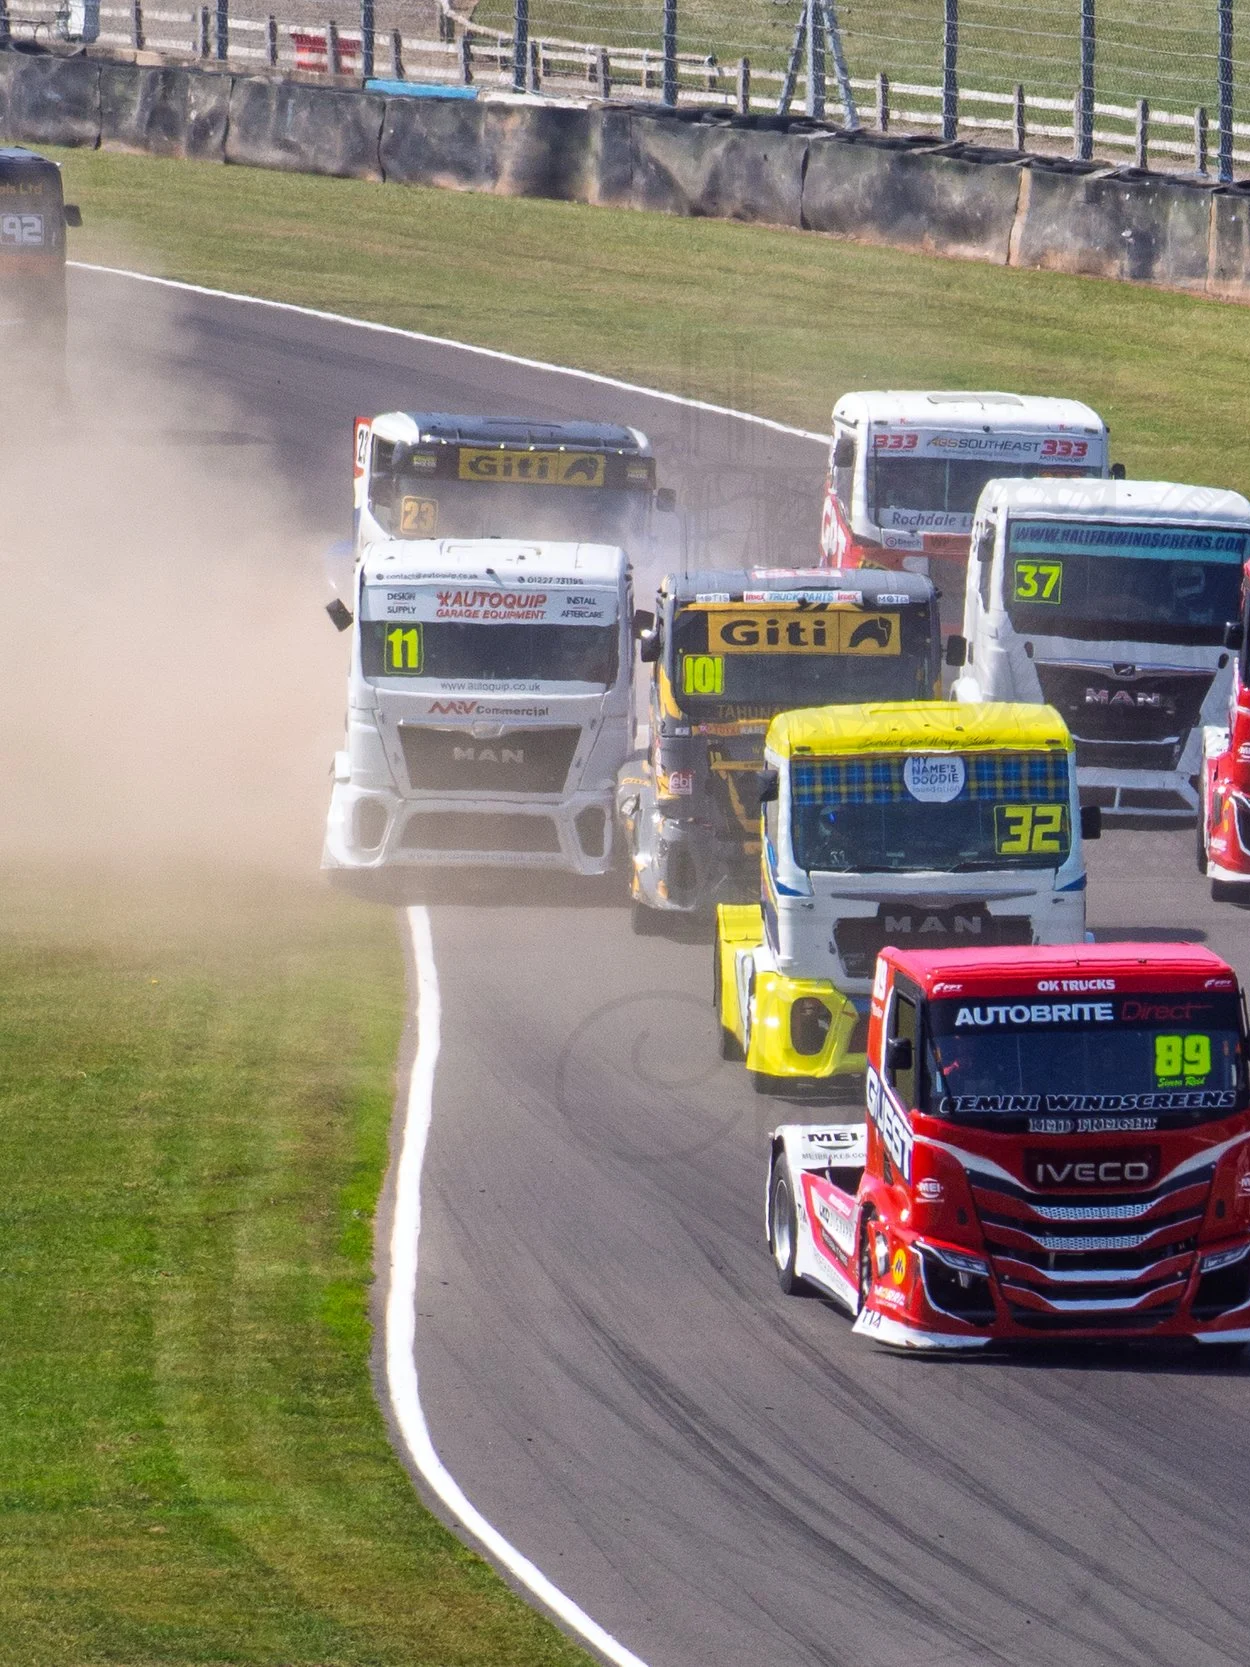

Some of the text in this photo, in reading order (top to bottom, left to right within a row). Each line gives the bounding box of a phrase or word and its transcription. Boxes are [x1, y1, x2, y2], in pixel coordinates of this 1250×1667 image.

[3, 215, 42, 243] 92
[872, 433, 919, 449] 333
[1040, 439, 1089, 457] 333
[468, 455, 550, 479] Giti
[404, 500, 435, 530] 23
[892, 511, 957, 527] Rochdale
[1016, 565, 1062, 599] 37
[387, 592, 416, 601] DESIGN
[451, 591, 548, 609] AUTOQUIP
[566, 596, 597, 606] INSTALL
[768, 592, 799, 603] TRUCK
[387, 606, 416, 614] SUPPLY
[436, 609, 547, 620] GARAGE EQUIPMENT
[561, 610, 605, 618] AFTERCARE
[720, 618, 827, 647] Giti
[388, 628, 419, 668] 11
[684, 656, 723, 694] 101
[440, 681, 541, 692] www.autoquip.co.uk
[1085, 687, 1162, 708] MAN
[476, 704, 549, 717] Commercial
[453, 747, 525, 763] MAN
[912, 756, 928, 766] MY
[1001, 805, 1063, 853] 32
[884, 914, 982, 934] MAN
[1037, 978, 1116, 992] OK TRUCKS
[954, 1001, 1213, 1027] AUTOBRITE Direct
[1154, 1034, 1212, 1077] 89
[939, 1091, 1236, 1113] GEMINI WINDSCREENS
[867, 1066, 914, 1181] GUEST
[1028, 1116, 1159, 1133] REID FREIGHT
[807, 1132, 859, 1142] MEI
[1036, 1161, 1150, 1183] IVECO
[919, 1181, 941, 1193] MEI
